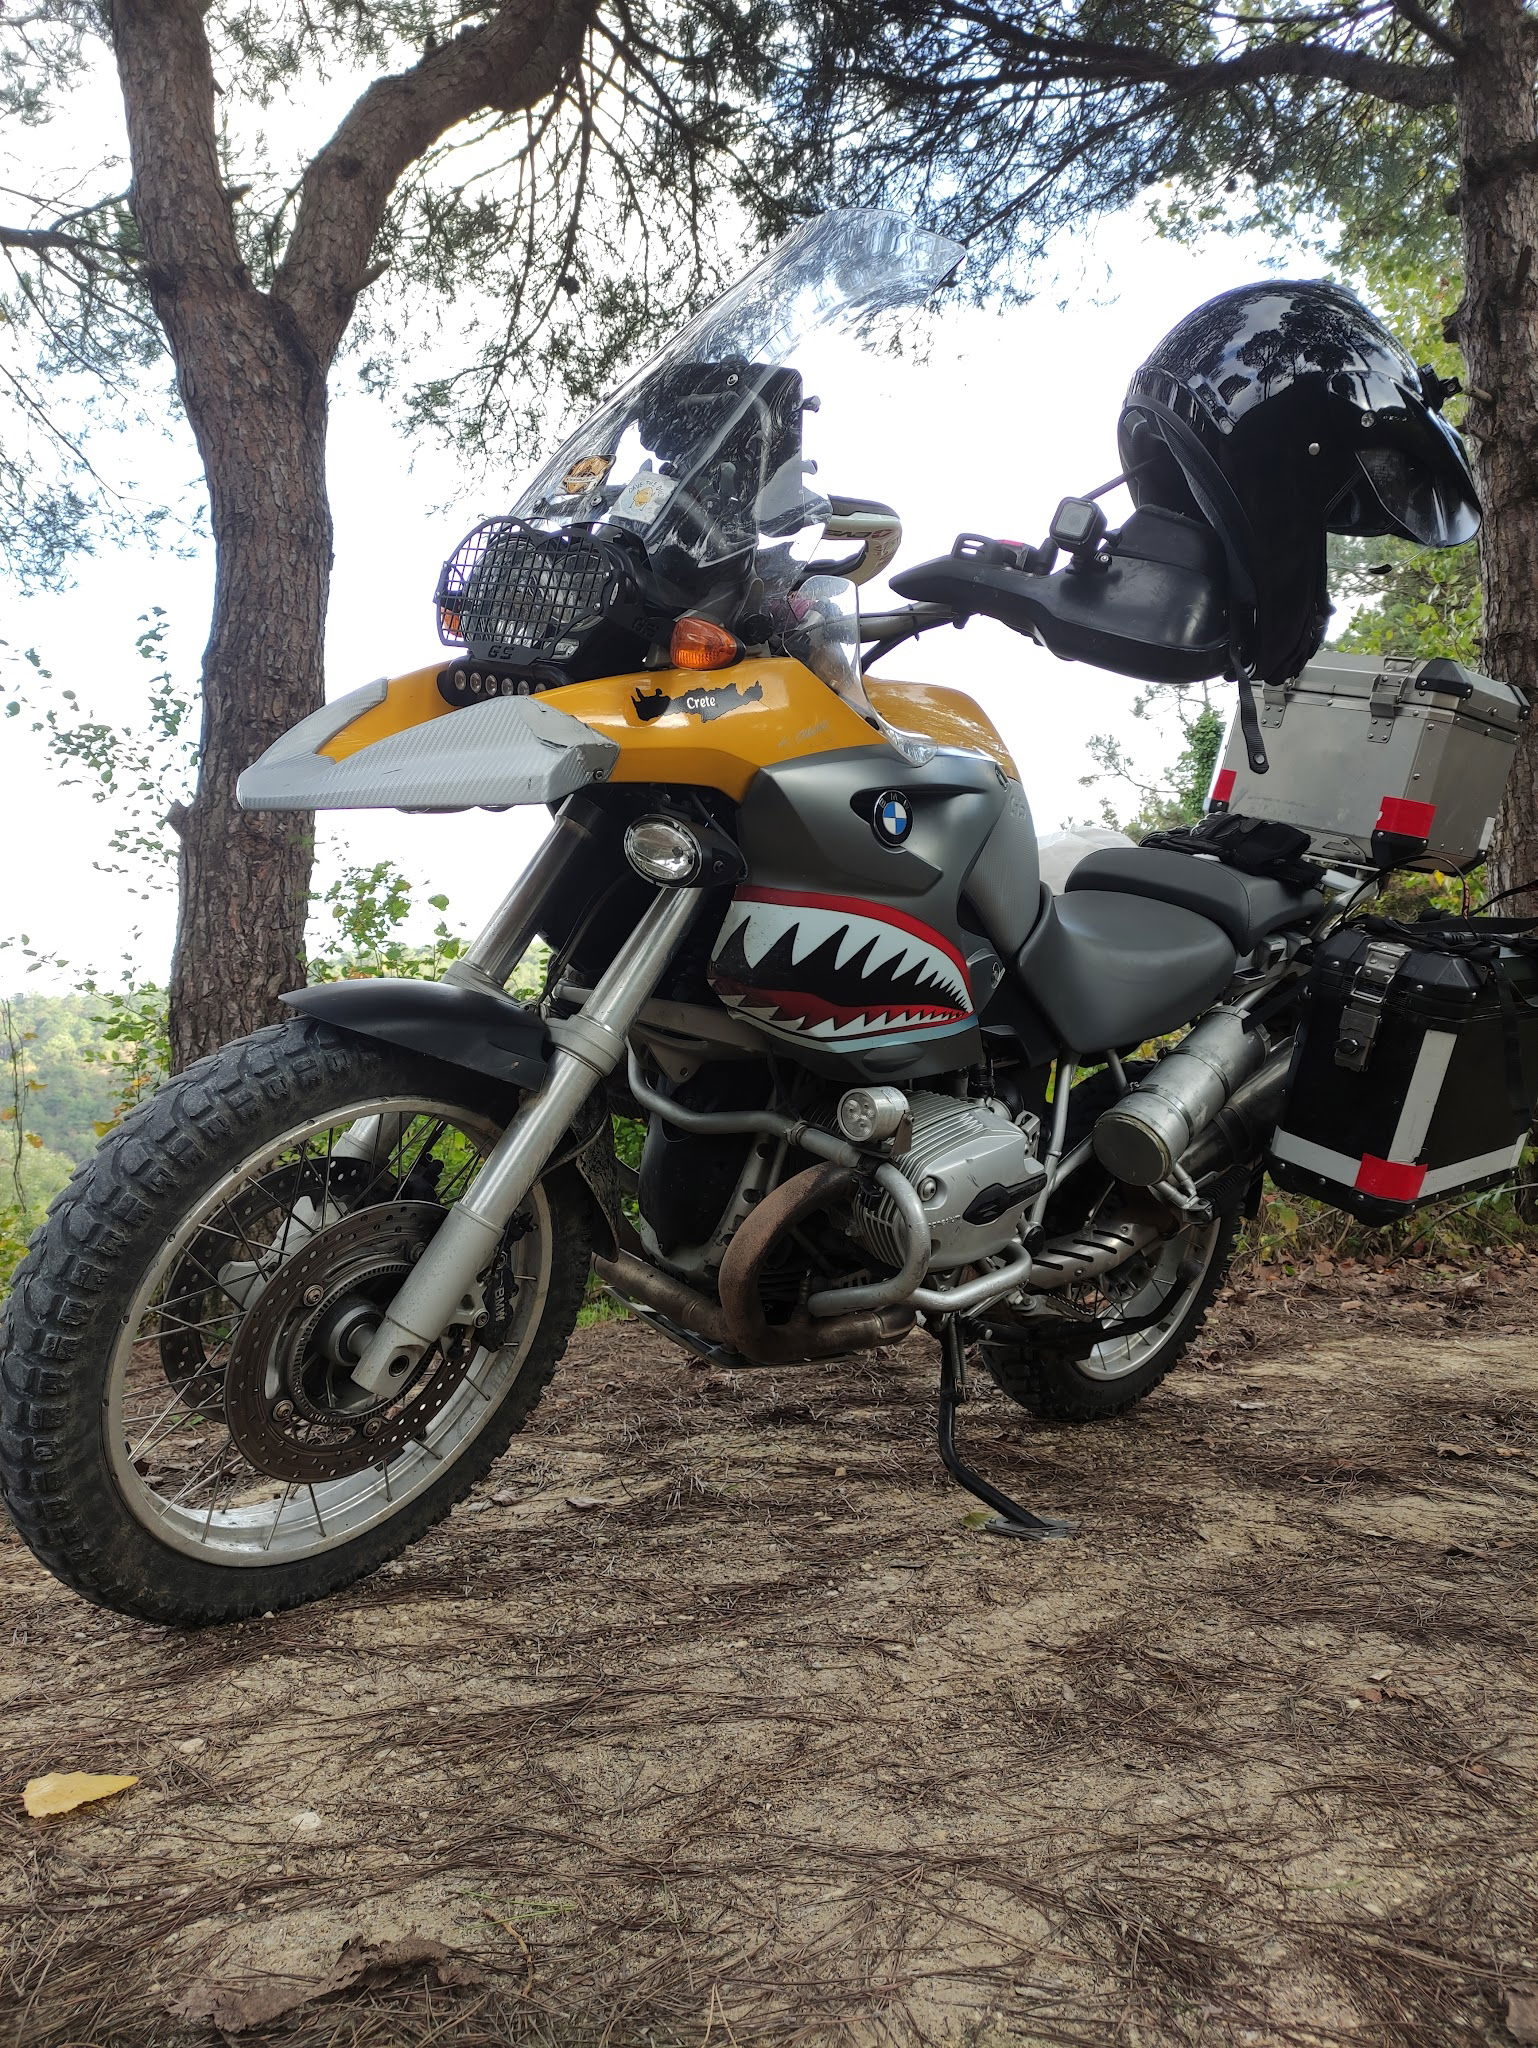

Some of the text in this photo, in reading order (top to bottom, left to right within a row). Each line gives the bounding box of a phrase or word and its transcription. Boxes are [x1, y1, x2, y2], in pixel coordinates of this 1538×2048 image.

[488, 645, 514, 659] GS
[686, 695, 716, 709] Crete
[879, 792, 909, 809] BMW
[495, 1287, 506, 1322] BMW
